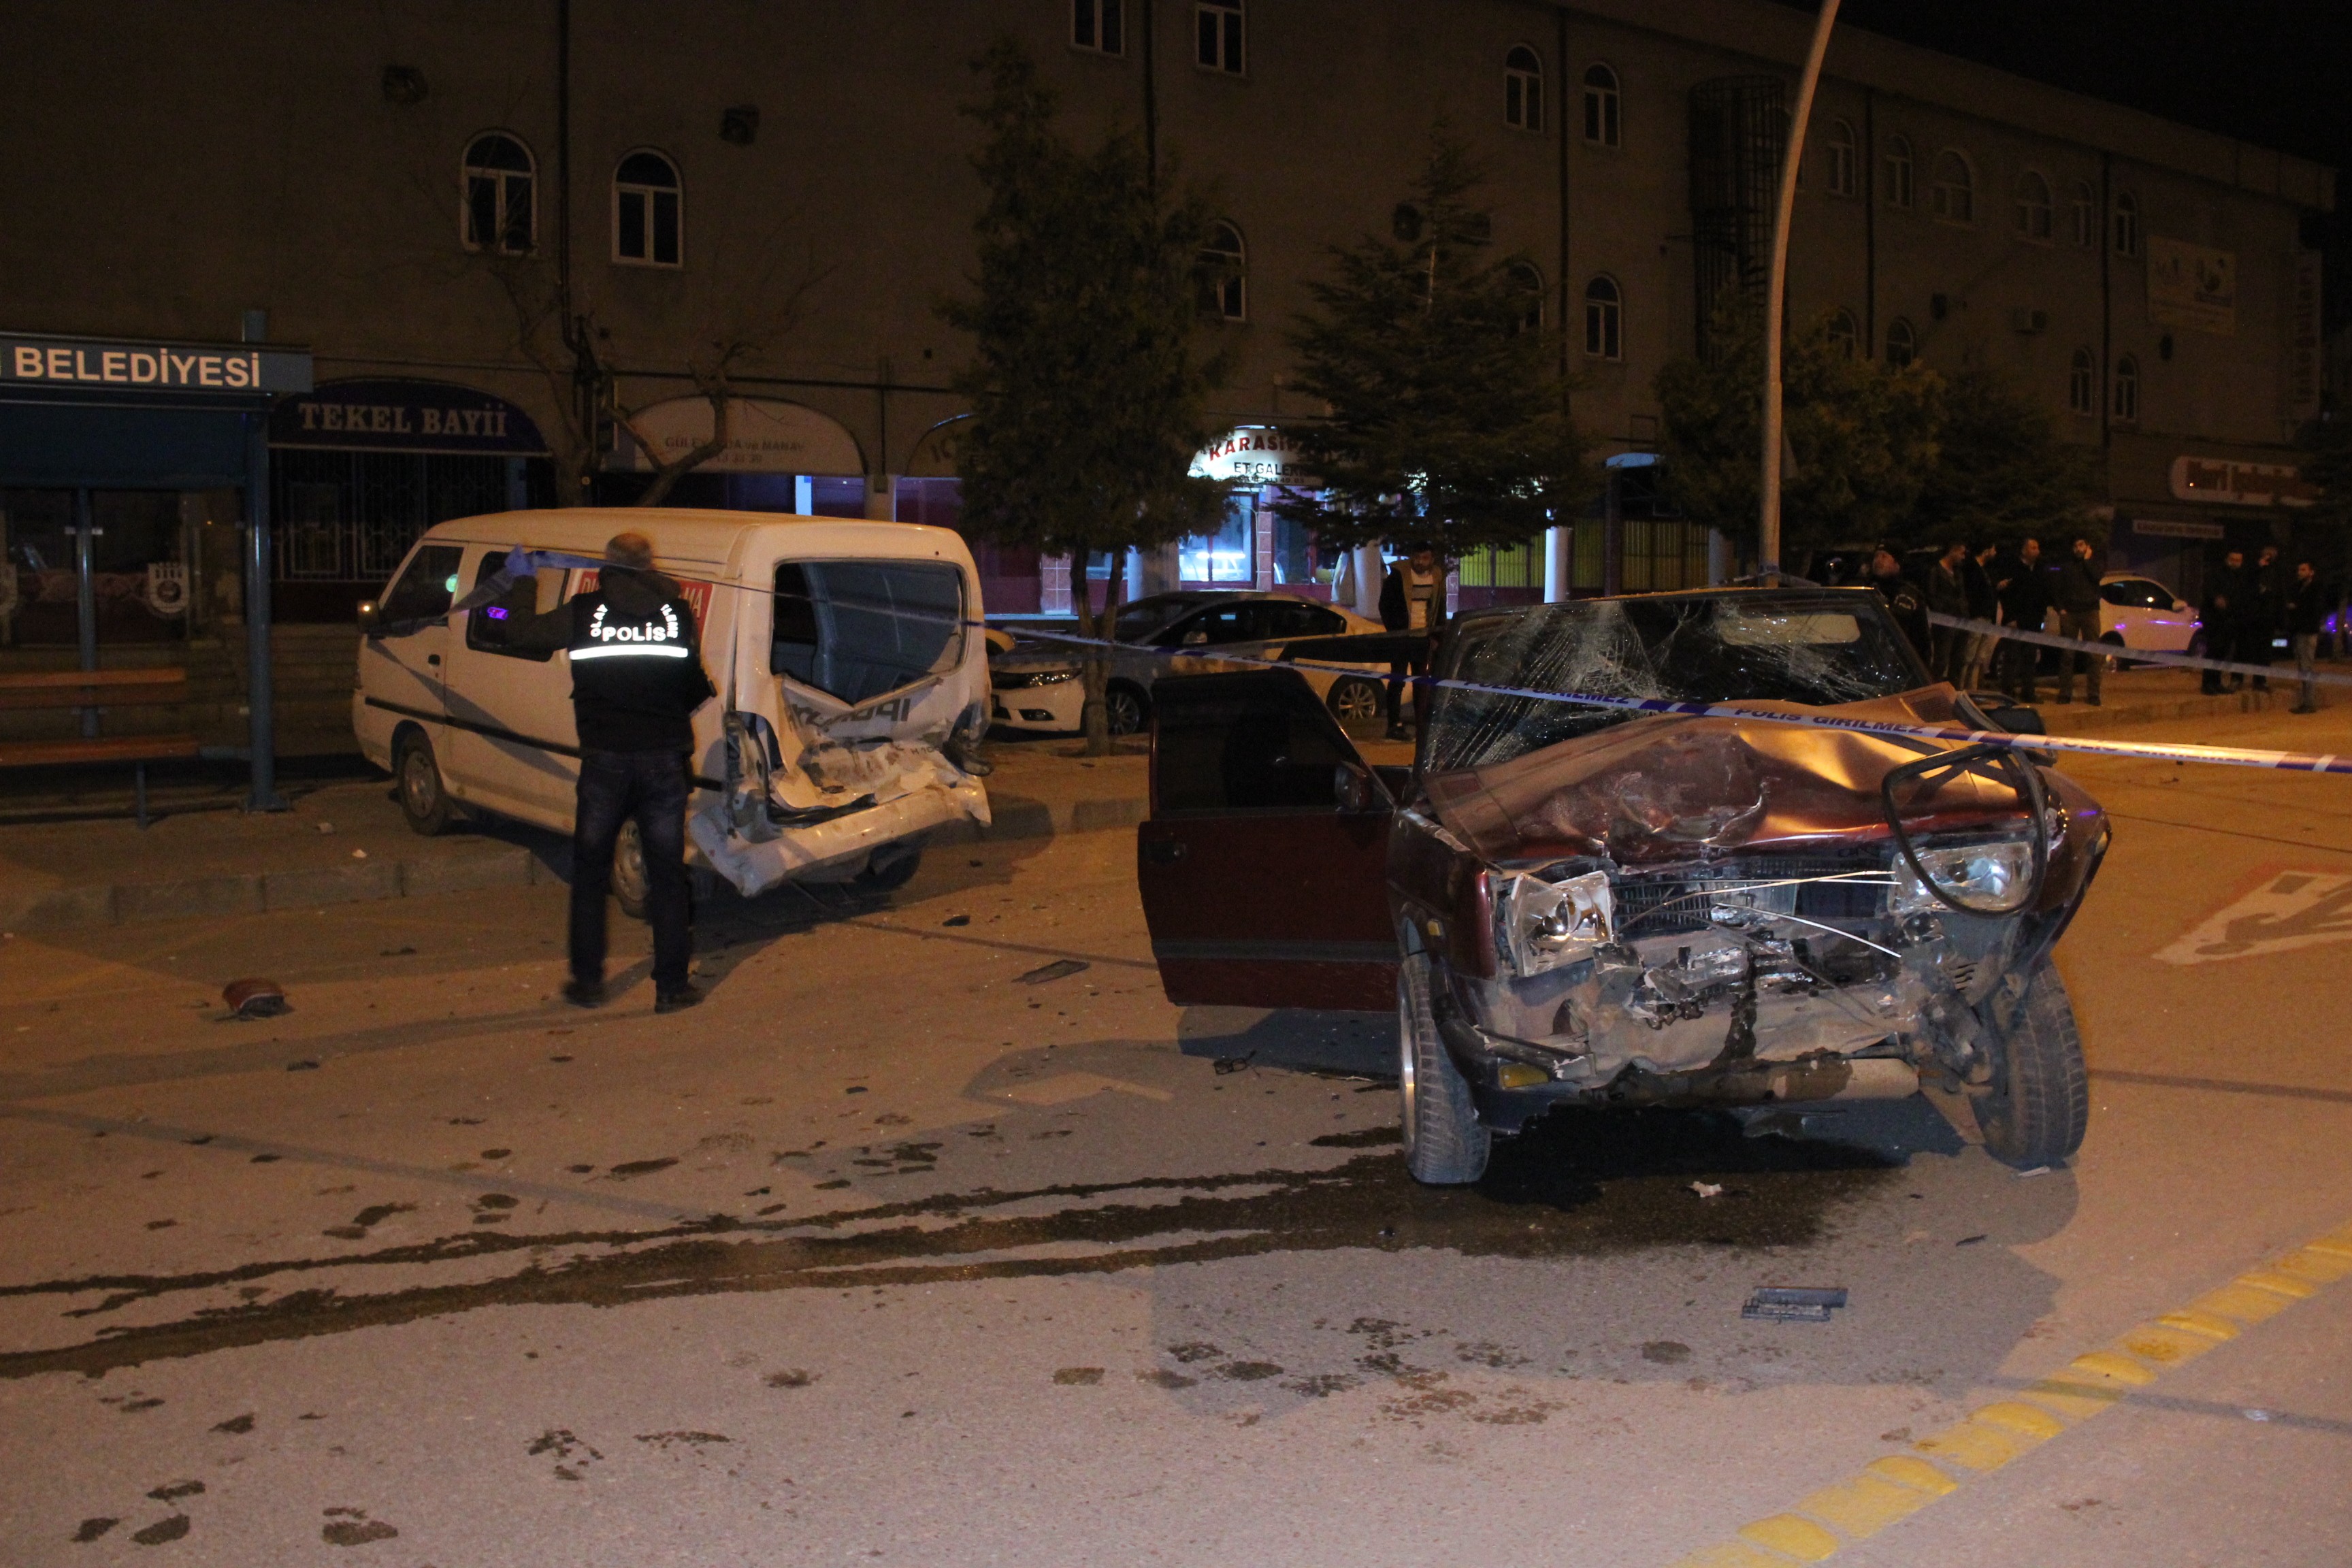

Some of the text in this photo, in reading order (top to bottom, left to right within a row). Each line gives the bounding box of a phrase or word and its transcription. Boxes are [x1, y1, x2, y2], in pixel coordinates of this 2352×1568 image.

[14, 346, 261, 388] BELEDİYESİ
[298, 402, 411, 434] TEKEL
[1234, 461, 1251, 474] ET
[602, 622, 666, 642] POLİS
